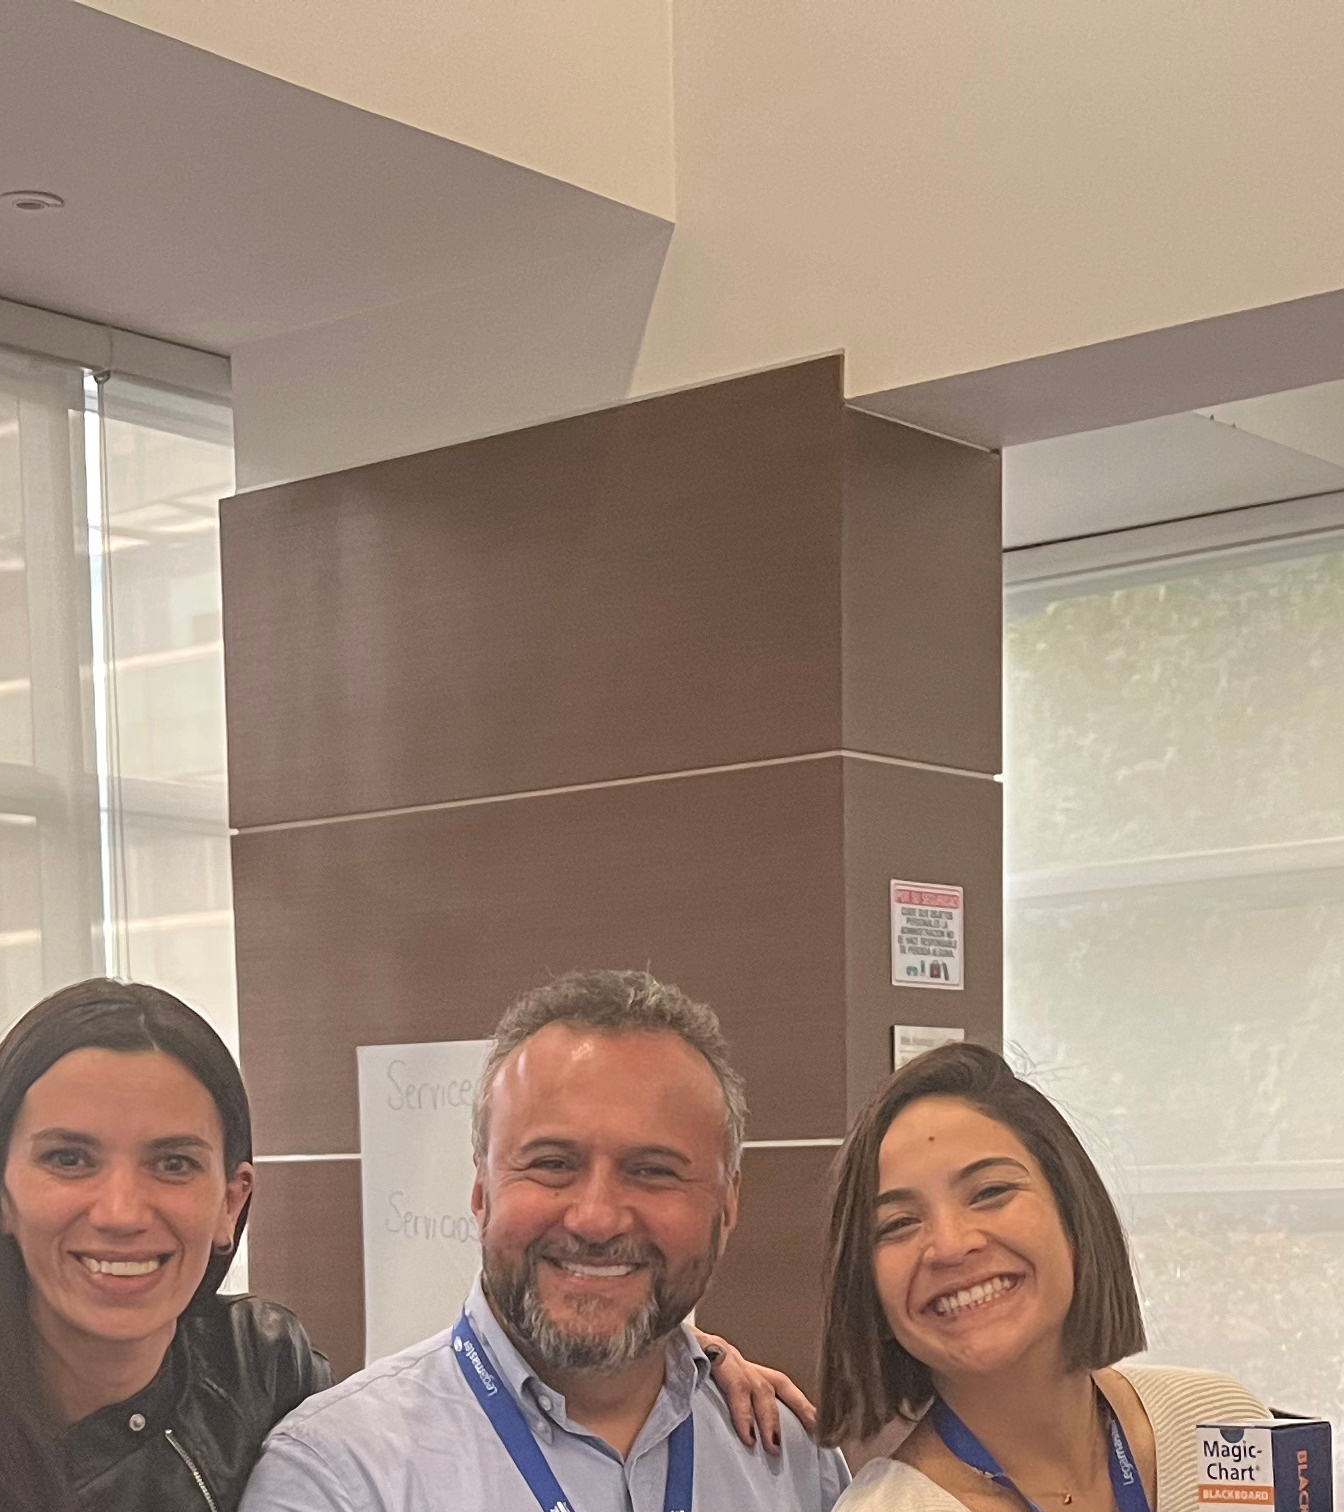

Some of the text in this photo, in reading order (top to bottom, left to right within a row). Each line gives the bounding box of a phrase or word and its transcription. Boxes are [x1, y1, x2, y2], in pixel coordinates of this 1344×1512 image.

[387, 1059, 478, 1111] Service
[463, 1339, 498, 1396] Legamaster
[1203, 1440, 1263, 1459] Magic-
[1202, 1489, 1269, 1501] BLACKBOARD
